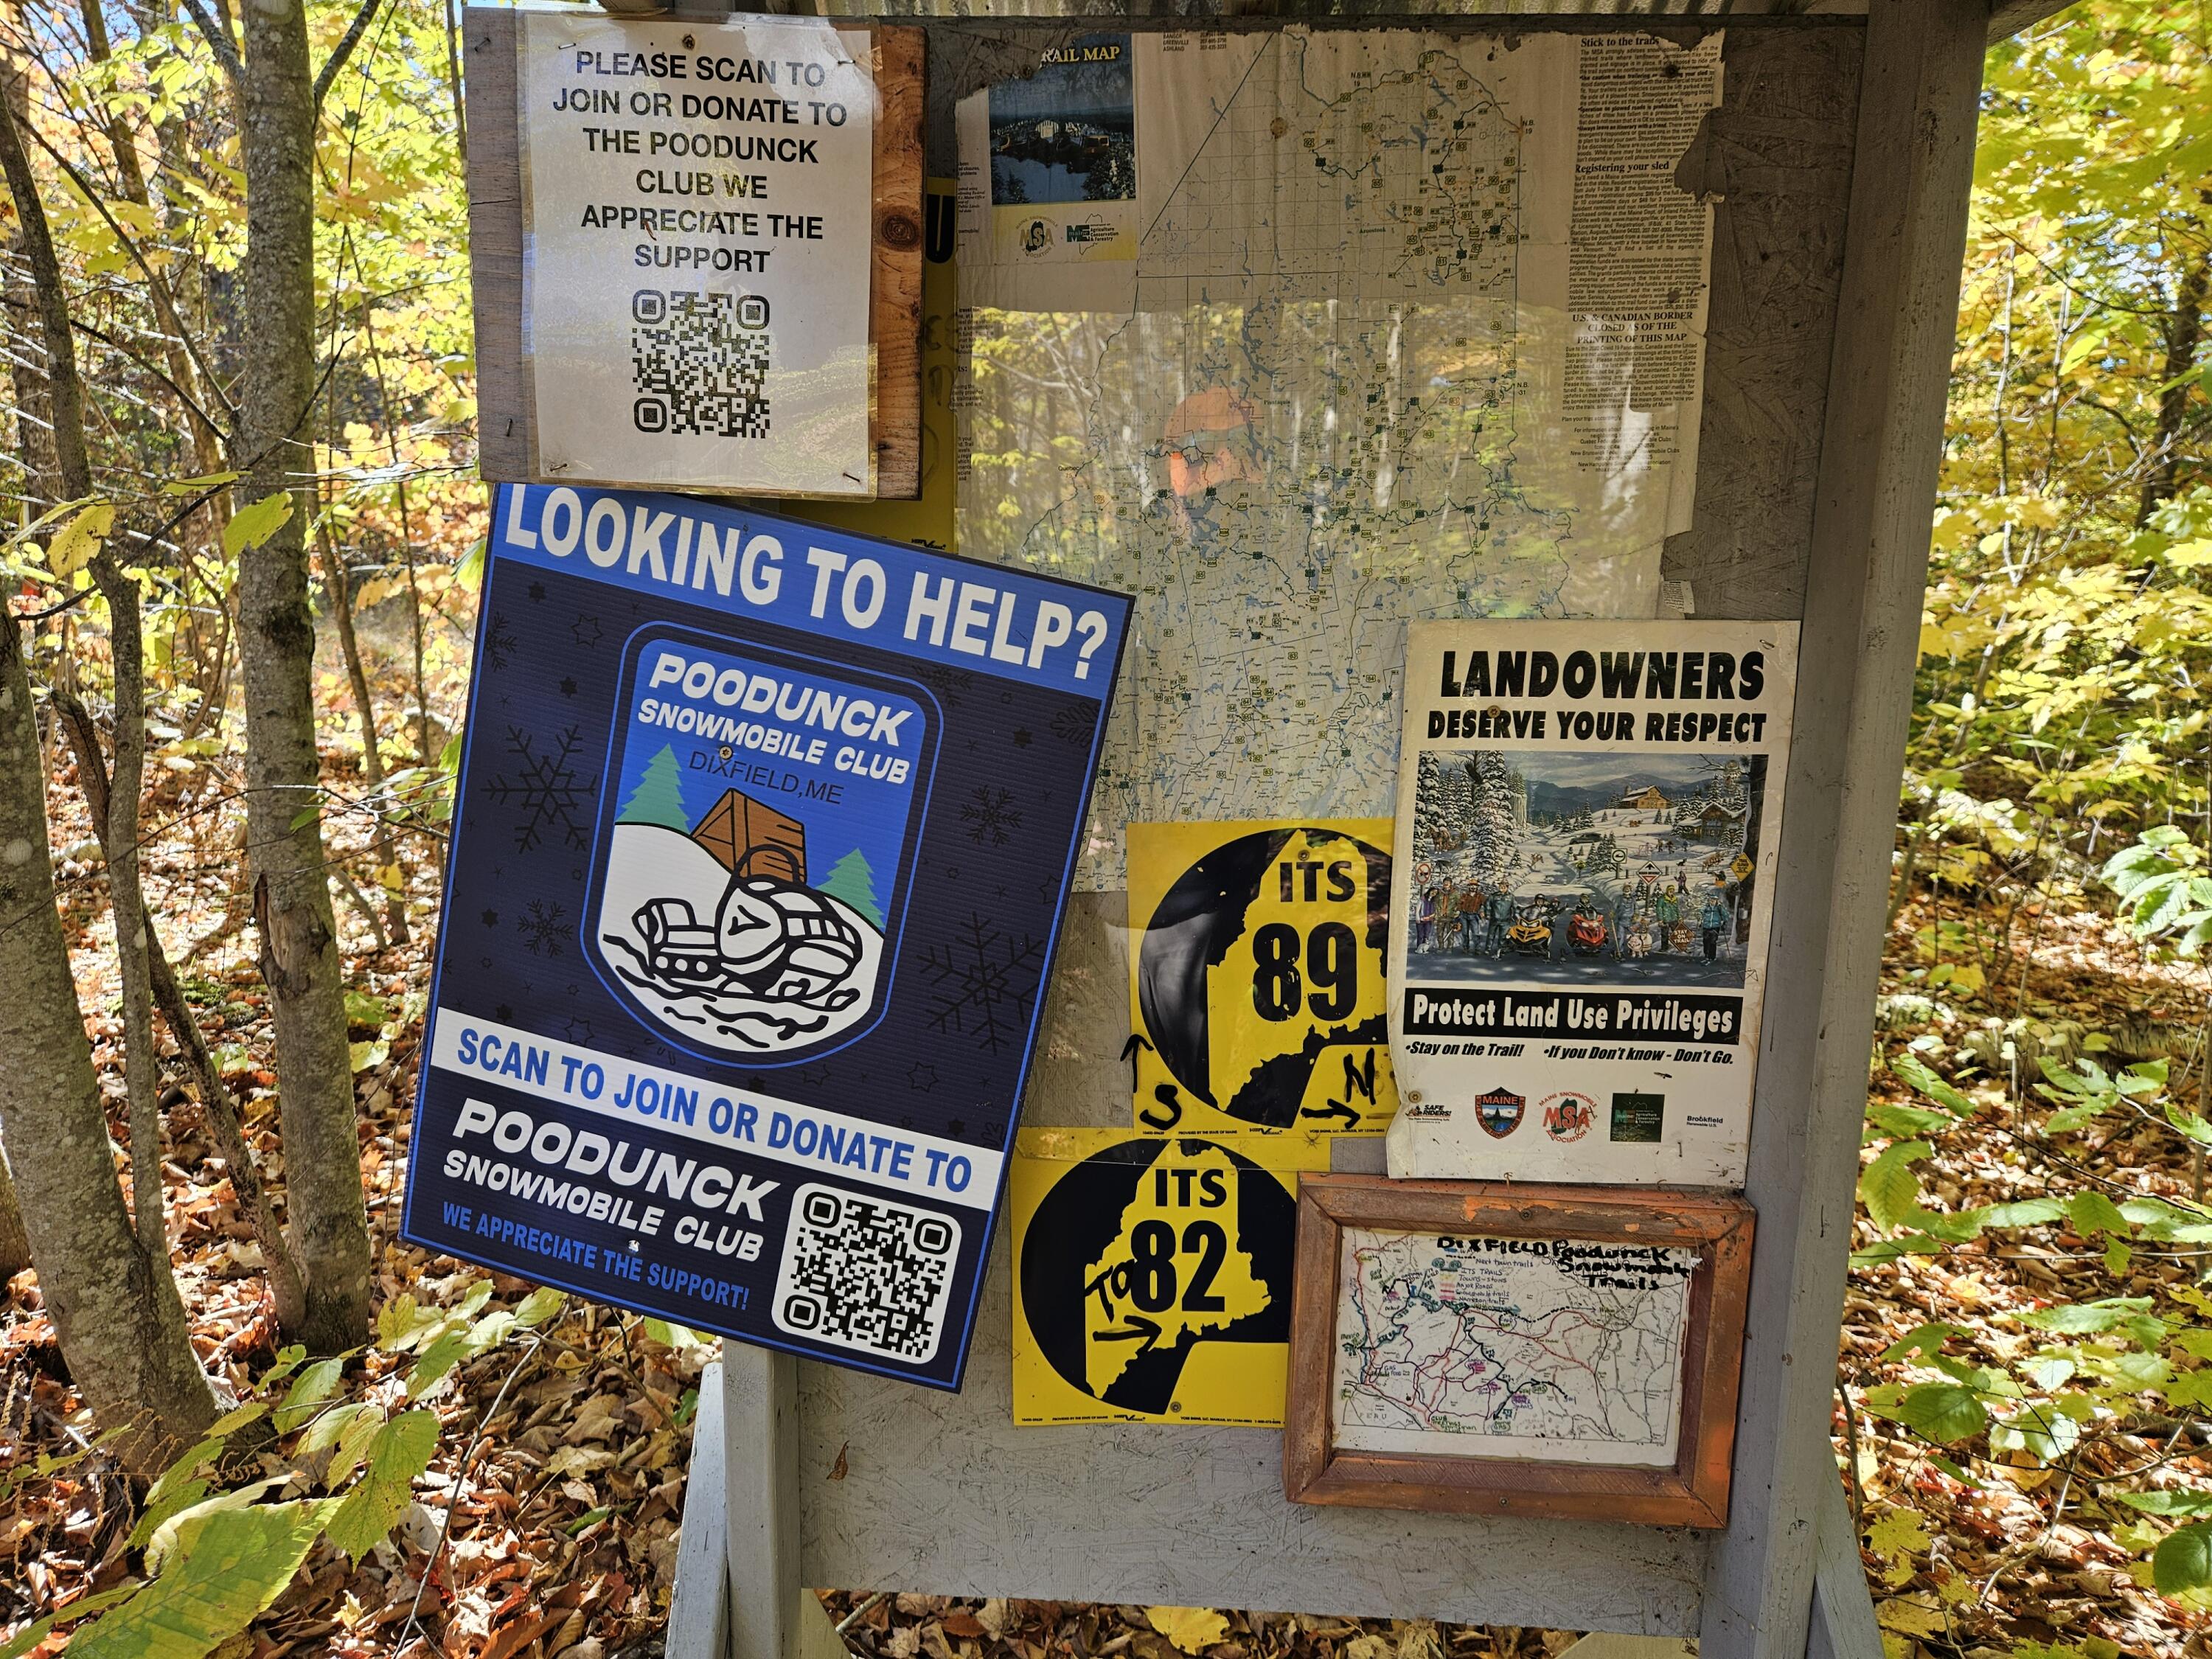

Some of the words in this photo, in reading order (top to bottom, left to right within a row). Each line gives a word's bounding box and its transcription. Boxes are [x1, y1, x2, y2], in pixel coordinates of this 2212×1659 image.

[1041, 47, 1080, 63] RAIL
[1083, 46, 1120, 61] MAP
[1581, 38, 1604, 47] Stick
[1607, 38, 1616, 46] to
[1618, 37, 1633, 46] the
[577, 51, 688, 80] PLEASE
[695, 56, 775, 85] SCAN
[786, 61, 825, 88] TO
[553, 88, 619, 115] JOIN
[630, 92, 672, 118] OR
[682, 95, 799, 125] DONATE
[807, 100, 847, 128] TO
[582, 128, 640, 154] THE
[650, 132, 818, 164] POODUNCK
[636, 169, 714, 196] CLUB
[723, 174, 768, 199] WE
[1575, 163, 1625, 174] Registering
[1627, 164, 1649, 173] your
[1652, 161, 1669, 170] sled
[581, 205, 758, 236] APPRECIATE
[768, 215, 823, 240] THE
[1019, 227, 1054, 246] MSA
[635, 245, 771, 273] SUPPORT
[1587, 323, 1625, 332] CLOSED
[1641, 322, 1656, 330] OF
[1657, 321, 1677, 330] THE
[1601, 313, 1652, 321] CANADIAN
[1654, 311, 1693, 320] BORDER
[1577, 335, 1622, 344] PRINTING
[1624, 334, 1639, 343] OF
[1640, 334, 1663, 342] THIS
[1665, 333, 1687, 341] MAP
[506, 484, 784, 605] LOOKING
[806, 547, 886, 630] TO
[904, 571, 1108, 680] HELP?
[1441, 650, 1764, 700] LANDOWNERS
[649, 653, 914, 746] POODUNCK
[639, 698, 828, 765] SNOWMOBILE
[835, 746, 911, 784] CLUB
[1427, 710, 1545, 740] DESERVE
[1558, 712, 1635, 741] YOUR
[1645, 712, 1767, 742] RESPECT
[1279, 860, 1356, 904] ITS
[1253, 922, 1359, 1023] 89
[1413, 995, 1496, 1028] Protect
[1503, 998, 1559, 1030] Land
[1568, 1000, 1608, 1030] Use
[1617, 1001, 1733, 1039] Privileges
[1442, 1044, 1458, 1054] on
[1462, 1043, 1485, 1056] the
[1487, 1044, 1525, 1057] Trail!
[1560, 1046, 1587, 1060] you
[1588, 1047, 1625, 1060] Don't
[1626, 1048, 1665, 1061] know
[1673, 1049, 1711, 1063] Don't
[1712, 1051, 1733, 1064] Go.
[1345, 1048, 1375, 1105] N
[457, 1028, 550, 1086] SCAN
[561, 1055, 605, 1100] TO
[614, 1074, 699, 1127] JOIN
[709, 1097, 759, 1142] OR
[768, 1113, 913, 1180] DONATE
[927, 1150, 972, 1193] TO
[1140, 1085, 1181, 1130] S
[1483, 1096, 1518, 1104] MAINE
[1539, 1093, 1557, 1107] MAINE
[1559, 1091, 1597, 1107] SNOWMOBILE
[1543, 1107, 1591, 1129] MSA
[1687, 1115, 1724, 1124] Brookfield
[1545, 1130, 1587, 1143] ASSOCIATION
[452, 1098, 780, 1221] POODUNCK
[443, 1150, 665, 1235] SNOWMOBILE
[674, 1215, 764, 1262] CLUB
[1155, 1169, 1227, 1208] ITS
[443, 1202, 470, 1231] WE
[476, 1214, 598, 1269] APPRECIATE
[604, 1249, 643, 1281] THE
[647, 1263, 749, 1310] SUPPORT!
[1130, 1220, 1226, 1313] 82
